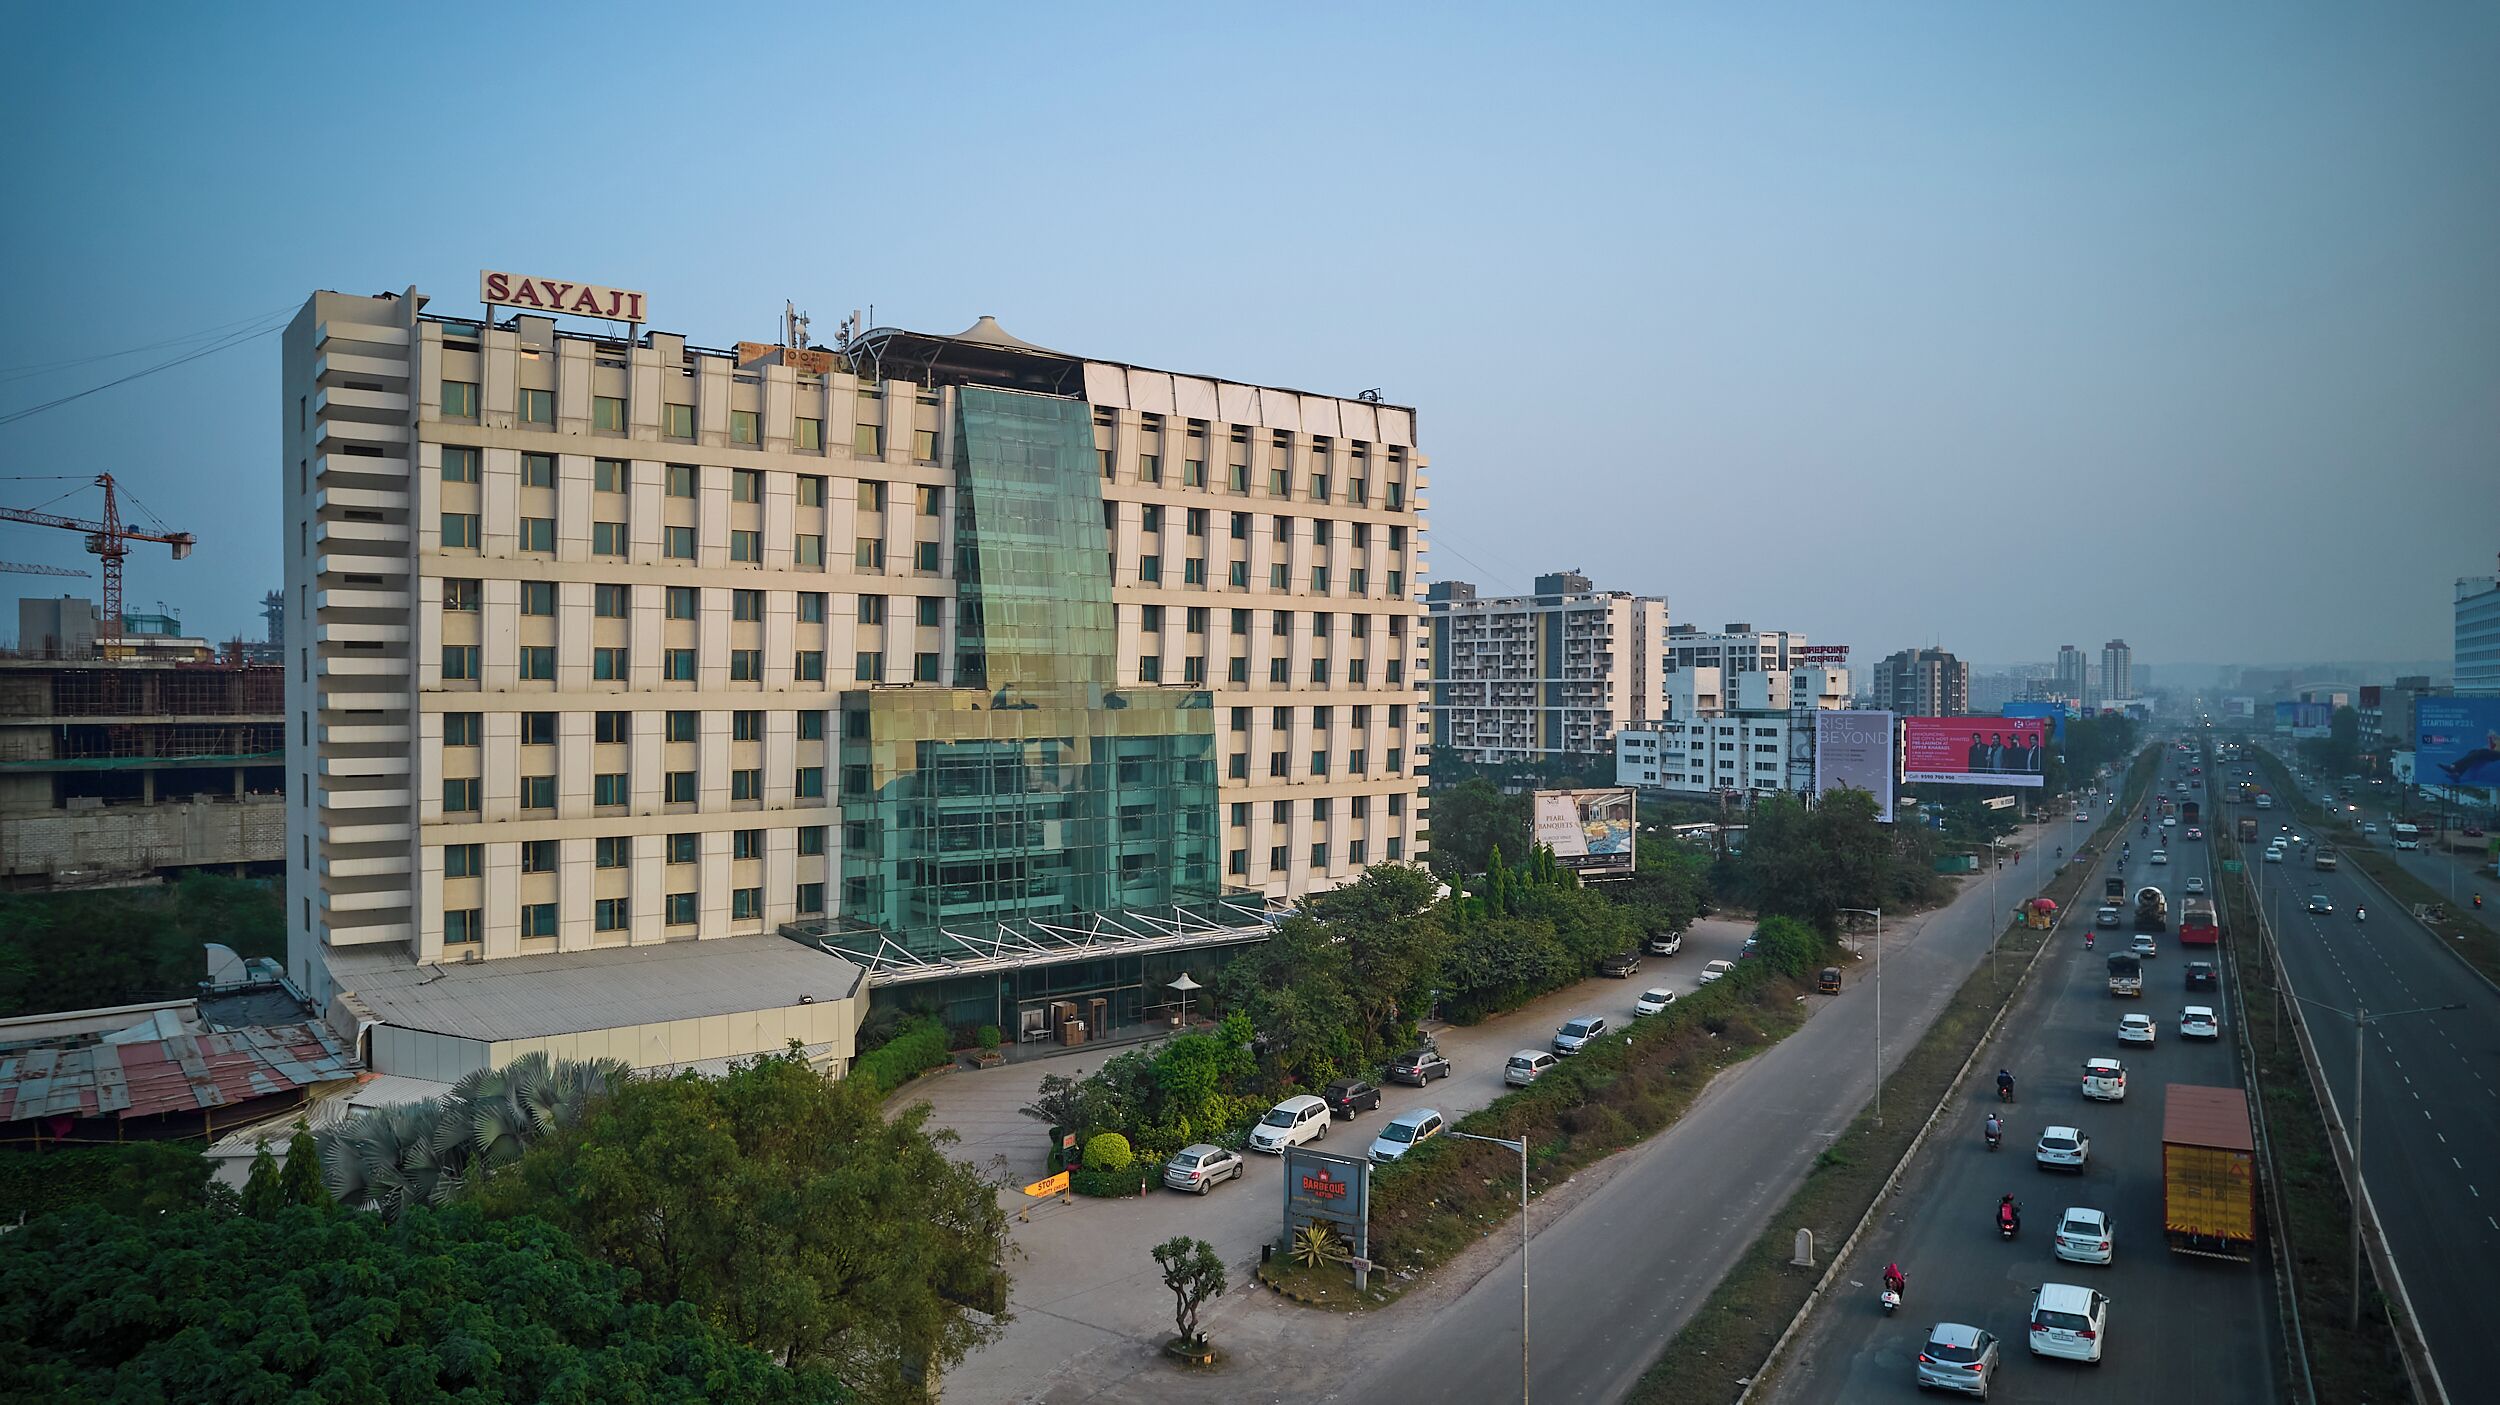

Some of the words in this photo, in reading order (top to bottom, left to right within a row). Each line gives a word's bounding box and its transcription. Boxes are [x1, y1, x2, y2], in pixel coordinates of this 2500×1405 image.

[487, 273, 642, 320] SAYAJI
[1820, 717, 1855, 730] RISE
[1820, 731, 1889, 745] BEYOND
[1538, 822, 1573, 830] BANQUETS
[1038, 1178, 1055, 1191] STOP
[1303, 1177, 1346, 1195] BARBEQUE
